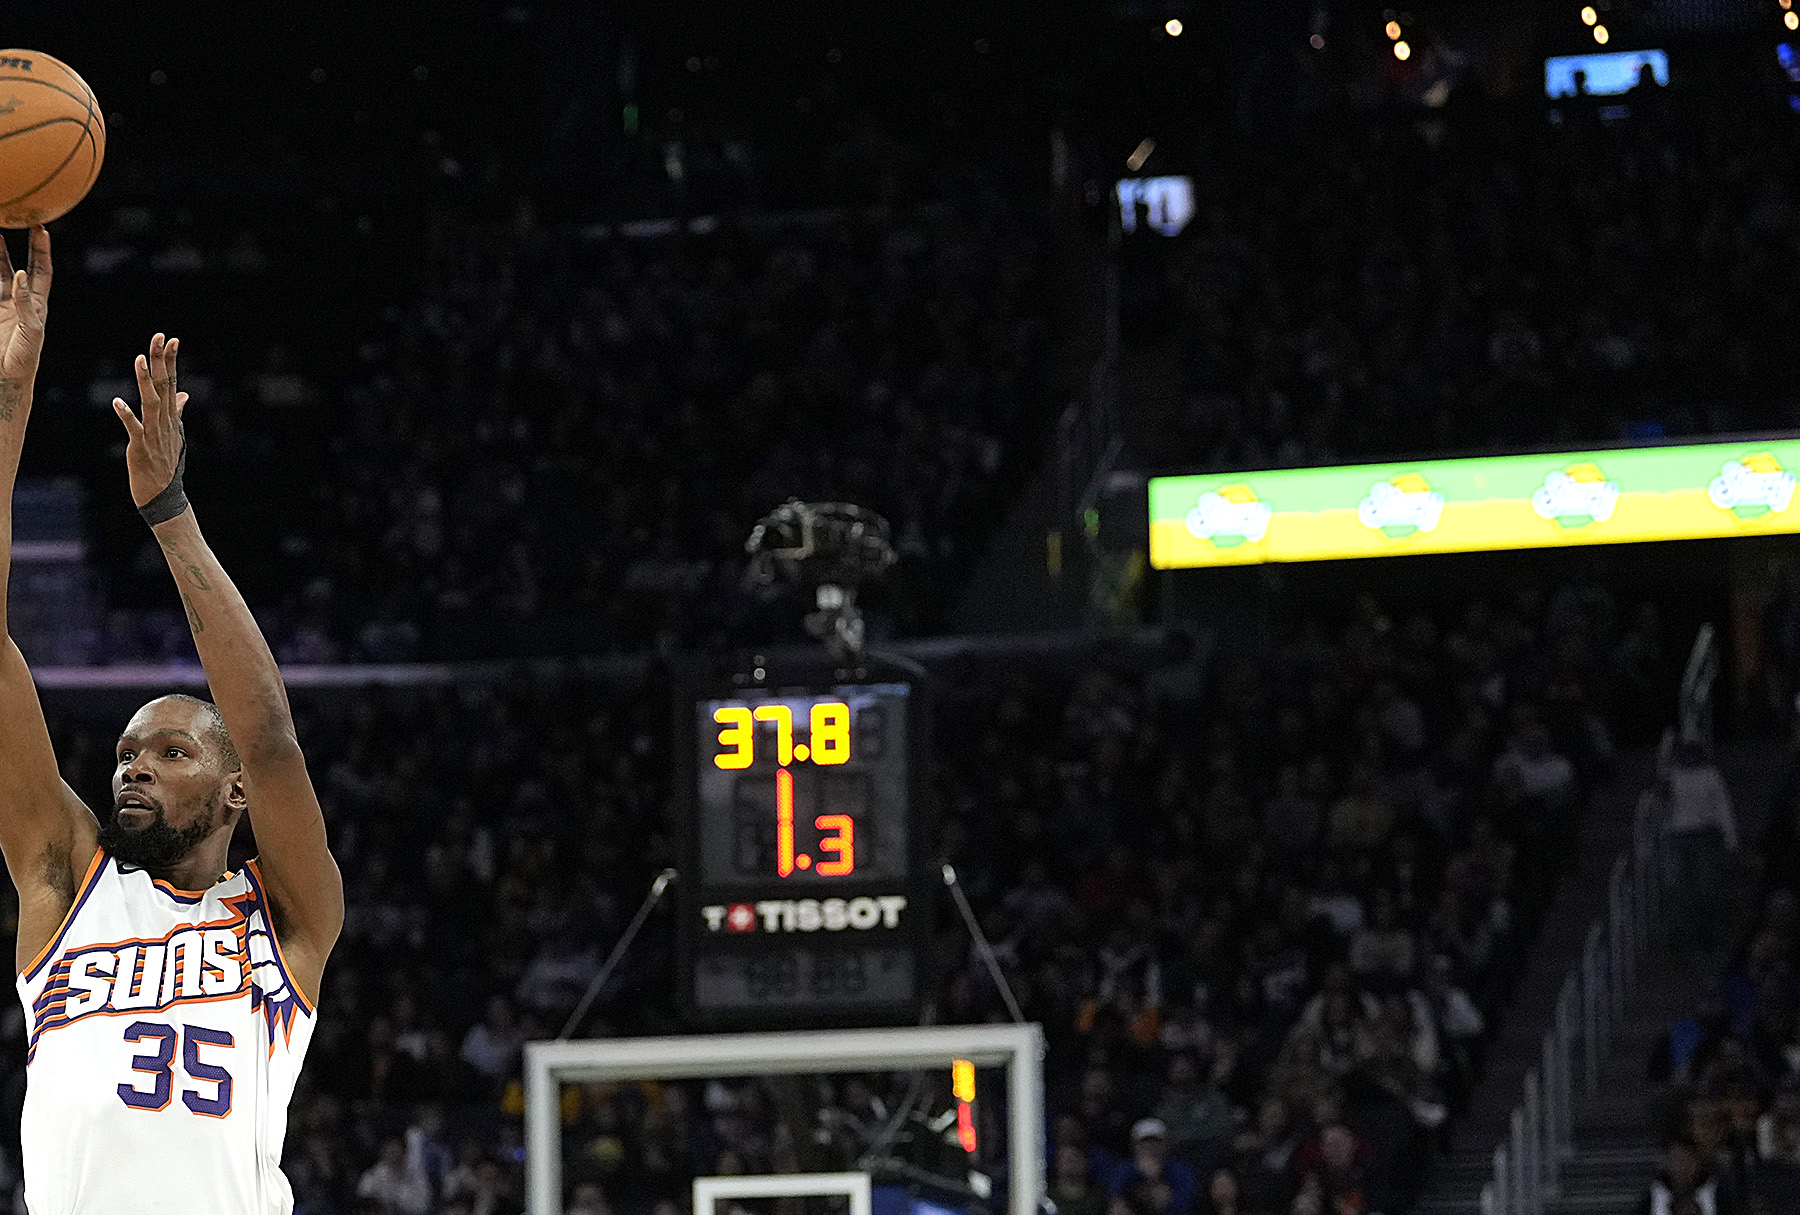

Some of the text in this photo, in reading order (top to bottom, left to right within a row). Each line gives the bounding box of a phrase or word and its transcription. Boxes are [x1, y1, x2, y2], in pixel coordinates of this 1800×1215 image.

[713, 702, 851, 770] 37.8
[757, 896, 908, 932] TISSOT
[65, 928, 244, 1020] SUNS
[117, 1020, 235, 1119] 35
